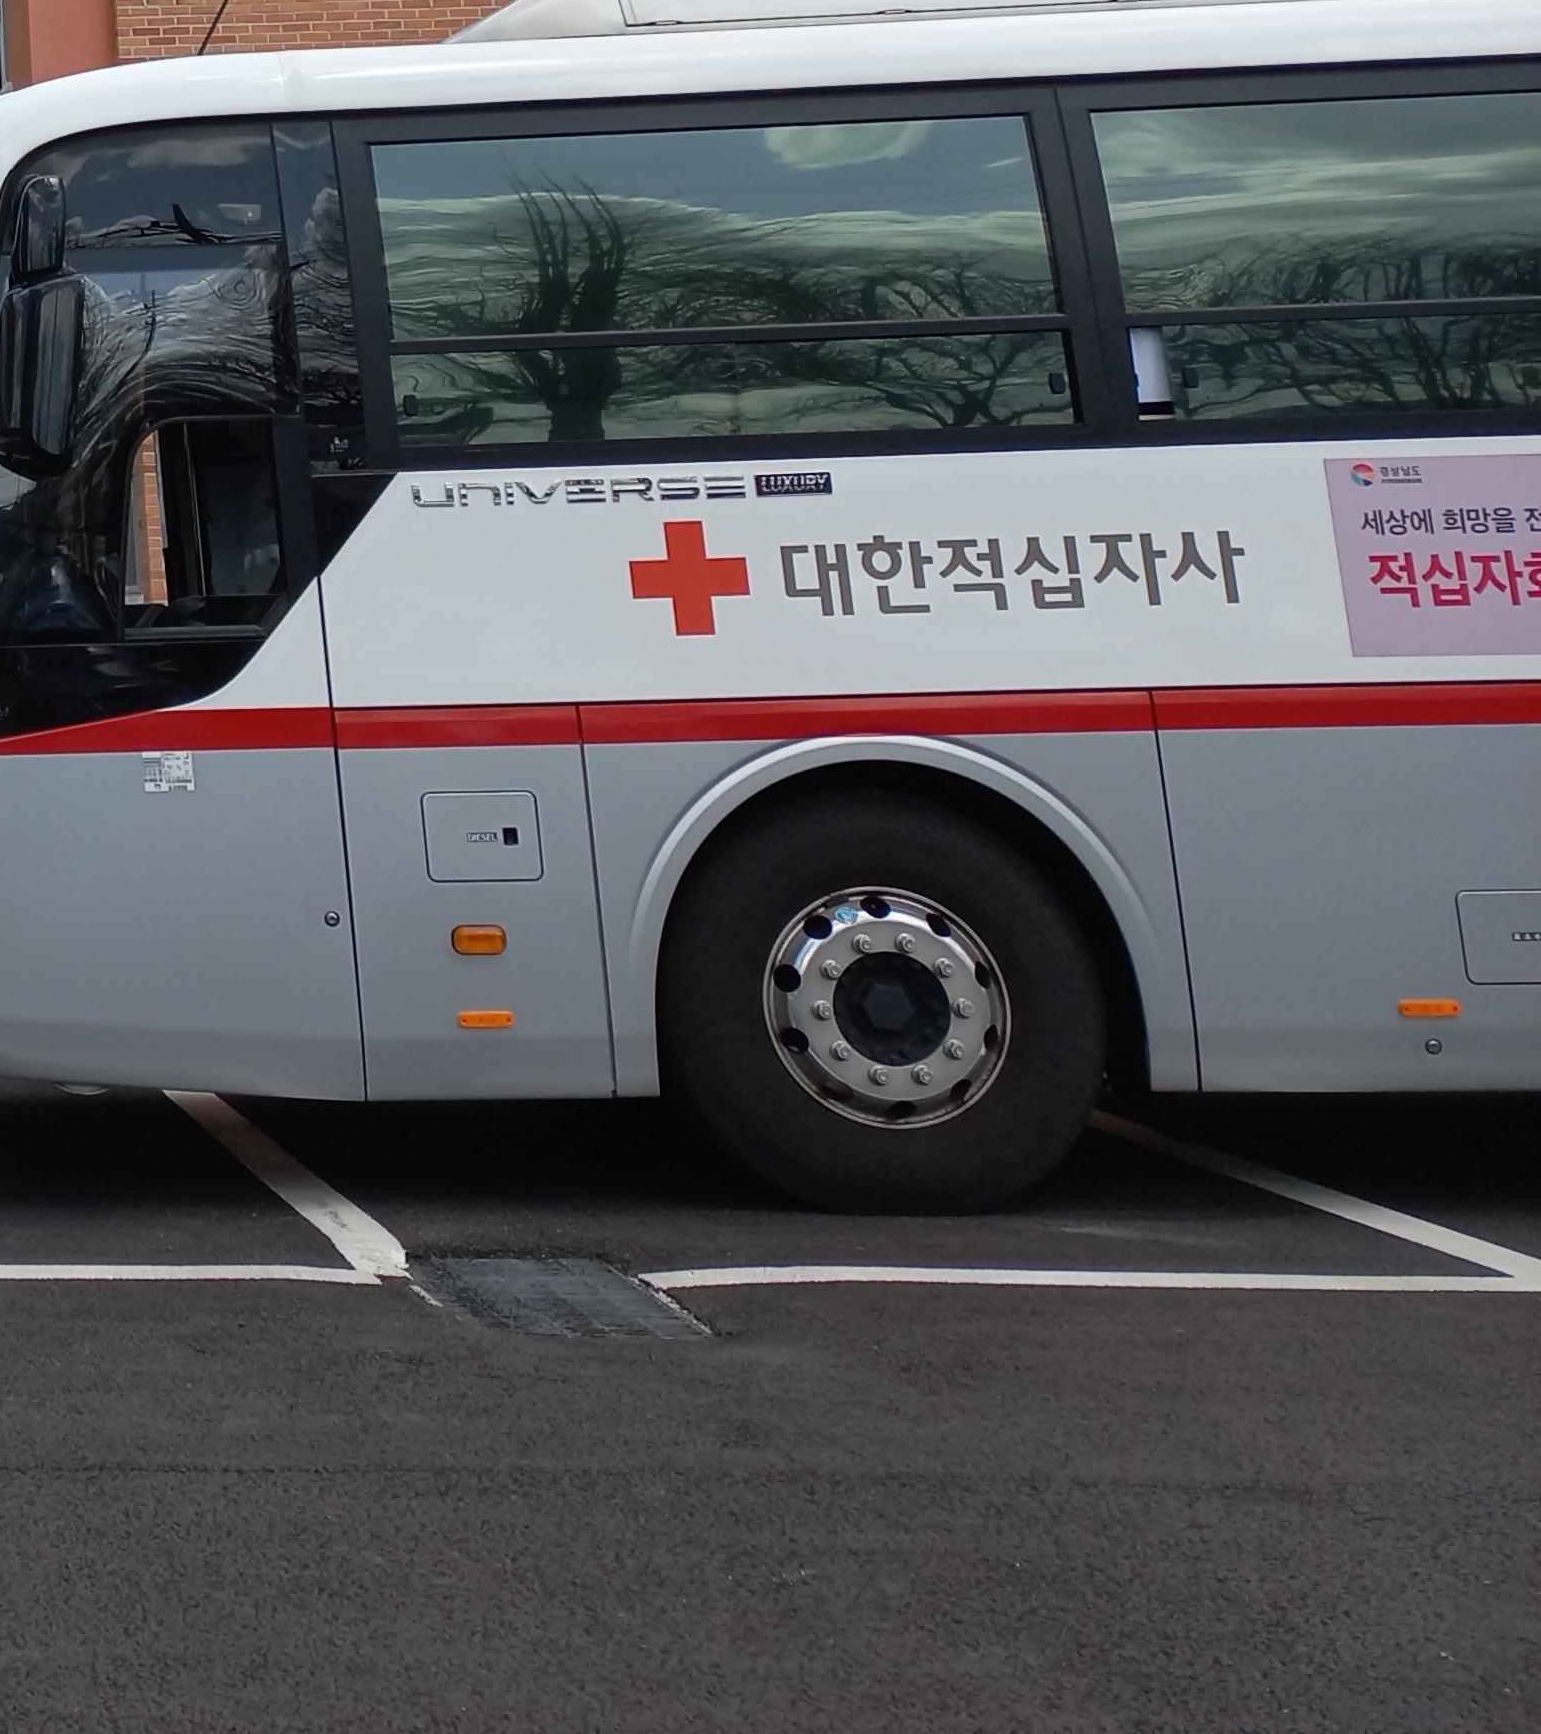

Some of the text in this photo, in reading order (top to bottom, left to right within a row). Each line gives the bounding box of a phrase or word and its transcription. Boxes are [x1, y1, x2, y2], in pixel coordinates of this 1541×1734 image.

[1379, 466, 1422, 477] 경상남도
[410, 473, 828, 507] UNIVERSE LUXURY
[1361, 508, 1435, 535] 세상에
[1442, 507, 1517, 534] 희망을
[779, 530, 1245, 616] 대한적십자사
[468, 833, 497, 842] DIESEL
